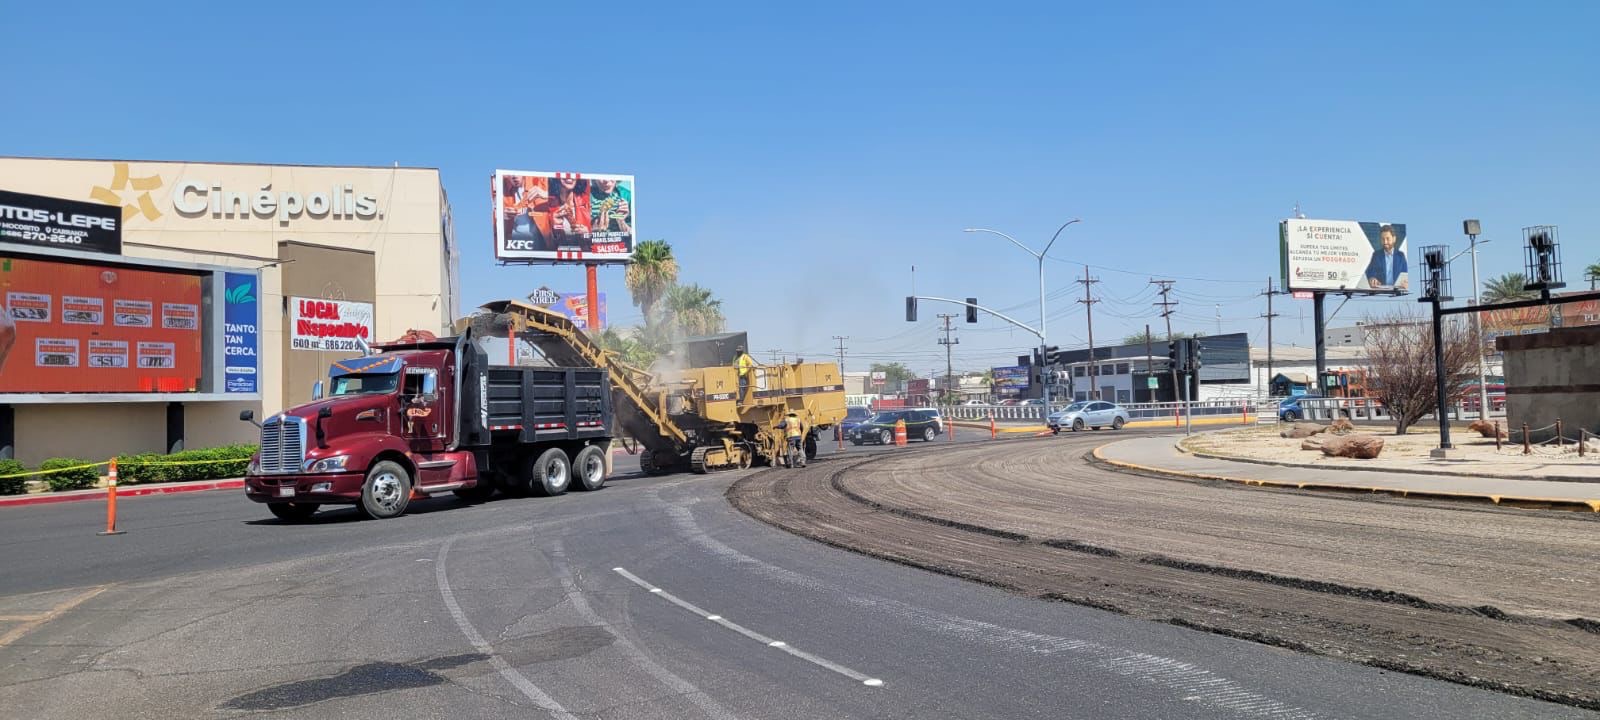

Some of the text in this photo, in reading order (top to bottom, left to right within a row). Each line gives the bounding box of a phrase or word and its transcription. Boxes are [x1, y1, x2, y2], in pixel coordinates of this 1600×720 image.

[23, 231, 82, 244] 270-2640
[52, 227, 88, 238] CARRANZA
[506, 239, 533, 250] KFC
[1328, 271, 1337, 279] 50
[533, 288, 554, 297] FIRST
[530, 296, 559, 304] STREET
[300, 299, 340, 320] LOCAL
[225, 323, 257, 334] TANTO.
[297, 319, 369, 339] Disponible
[225, 335, 243, 344] TAN
[294, 338, 309, 348] 600
[225, 346, 257, 356] CERCA.
